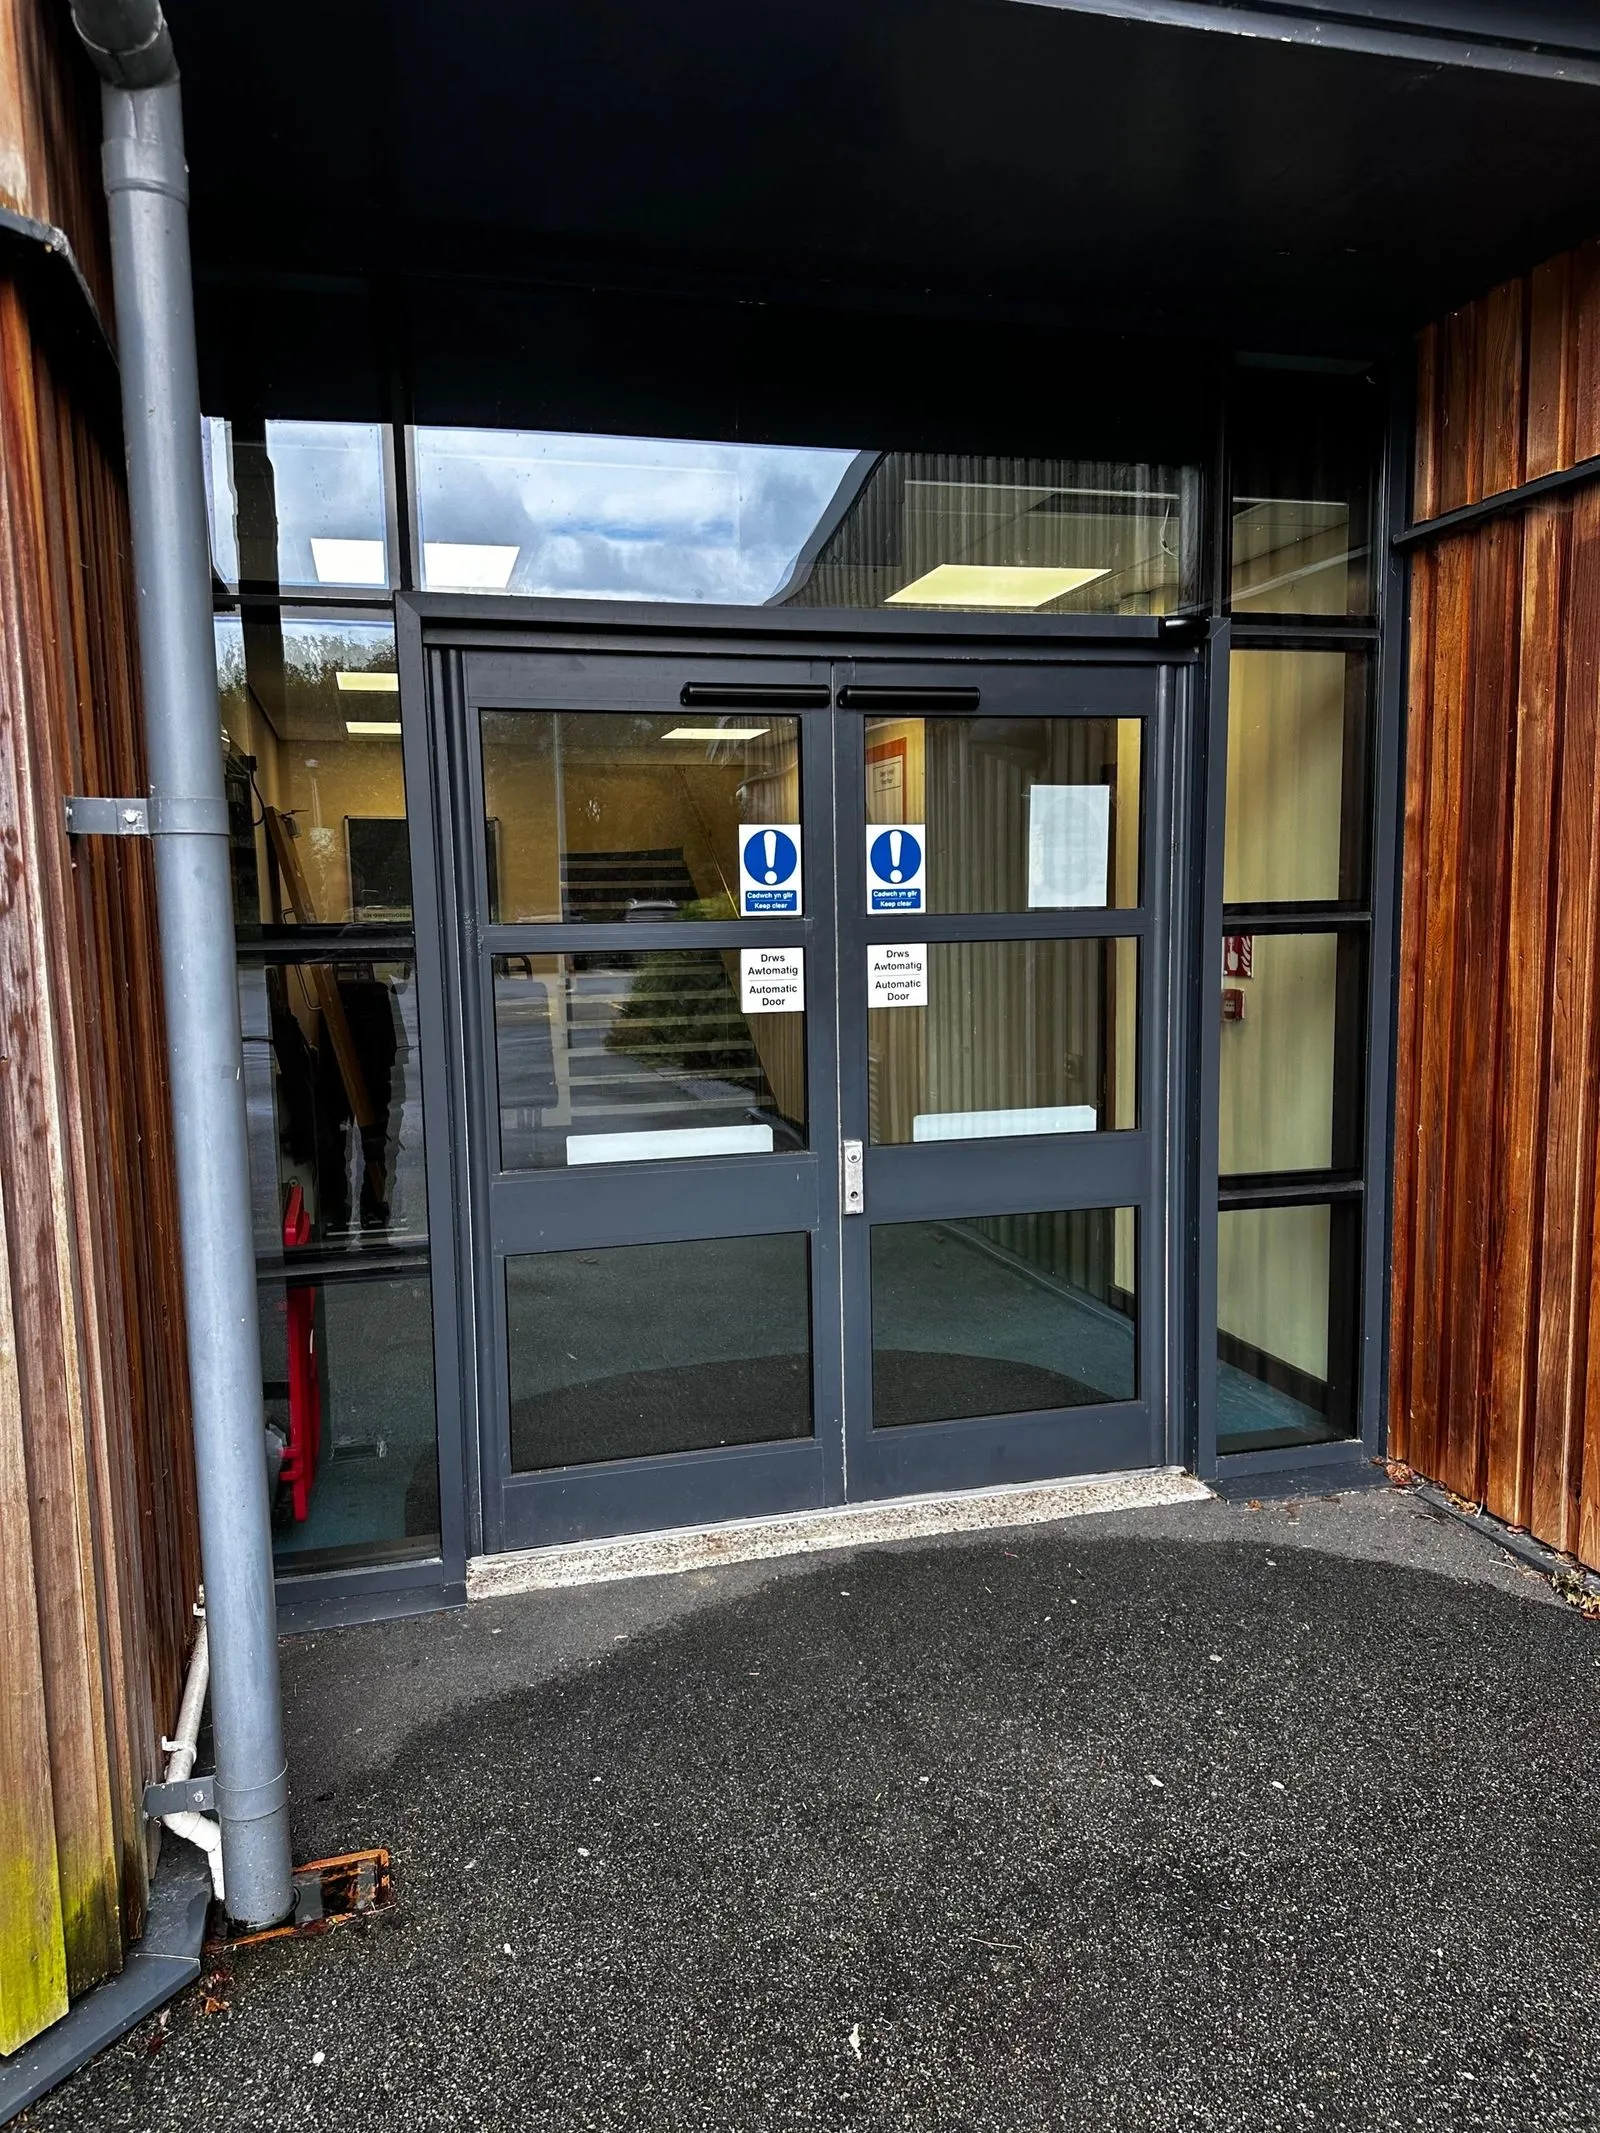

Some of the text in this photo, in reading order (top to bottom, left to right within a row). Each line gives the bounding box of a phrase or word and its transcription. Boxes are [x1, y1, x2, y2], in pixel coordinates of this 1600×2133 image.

[773, 892, 782, 900] yn
[754, 902, 771, 910] Keep
[880, 900, 896, 908] Keep
[760, 953, 786, 963] Drws
[886, 949, 910, 959] Drws
[748, 965, 798, 976] Awtomatig
[874, 961, 922, 972] Awtomatig
[749, 984, 798, 994] Automatic
[875, 980, 922, 990] Automatic
[762, 997, 786, 1006] Door
[887, 992, 910, 1001] Door
